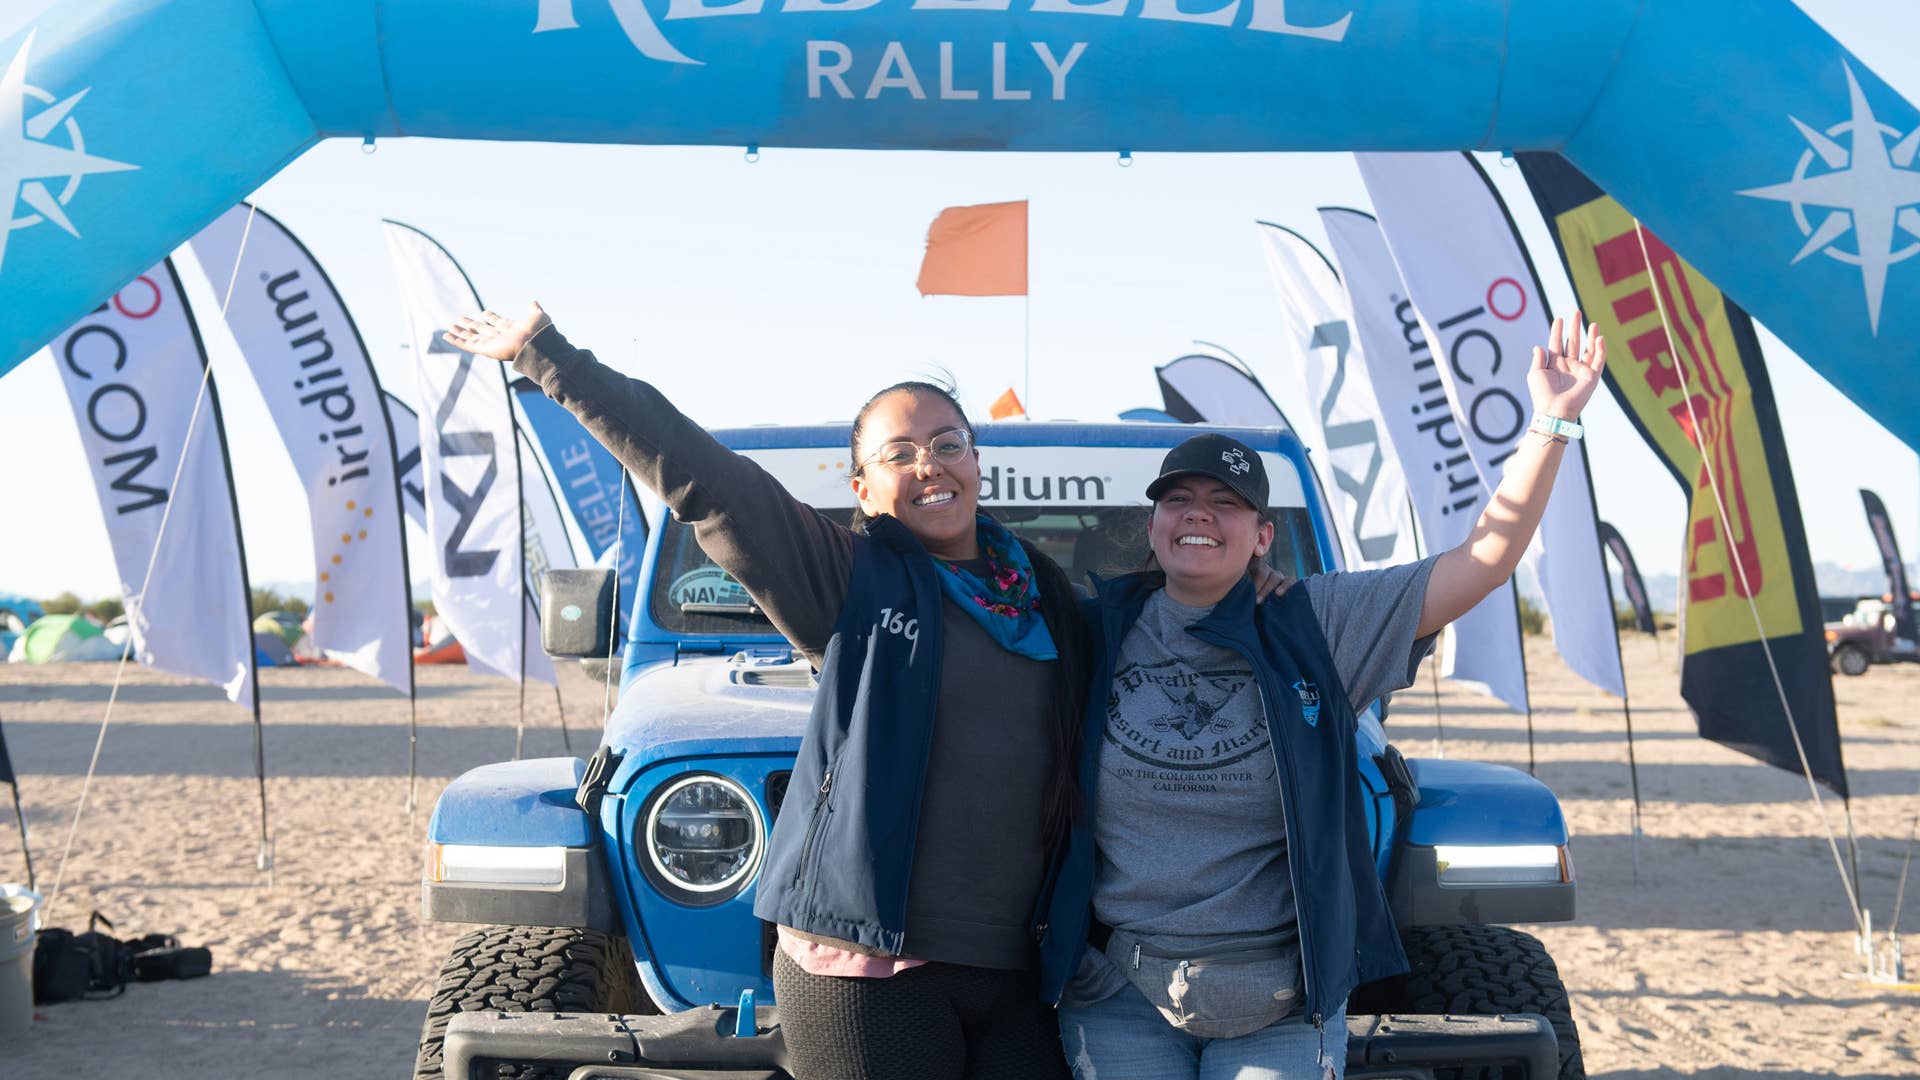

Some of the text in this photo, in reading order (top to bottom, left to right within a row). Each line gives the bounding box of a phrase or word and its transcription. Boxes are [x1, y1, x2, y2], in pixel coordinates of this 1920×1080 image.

[805, 39, 1089, 101] RALLY
[266, 269, 370, 487] iridium
[979, 466, 1105, 501] dium
[1117, 669, 1200, 694] Pirate
[1166, 745, 1204, 761] and
[1211, 716, 1268, 758] Mari
[1117, 767, 1253, 782] ON THE COLORADO RIVER
[1153, 782, 1217, 793] CALIFORNIA
